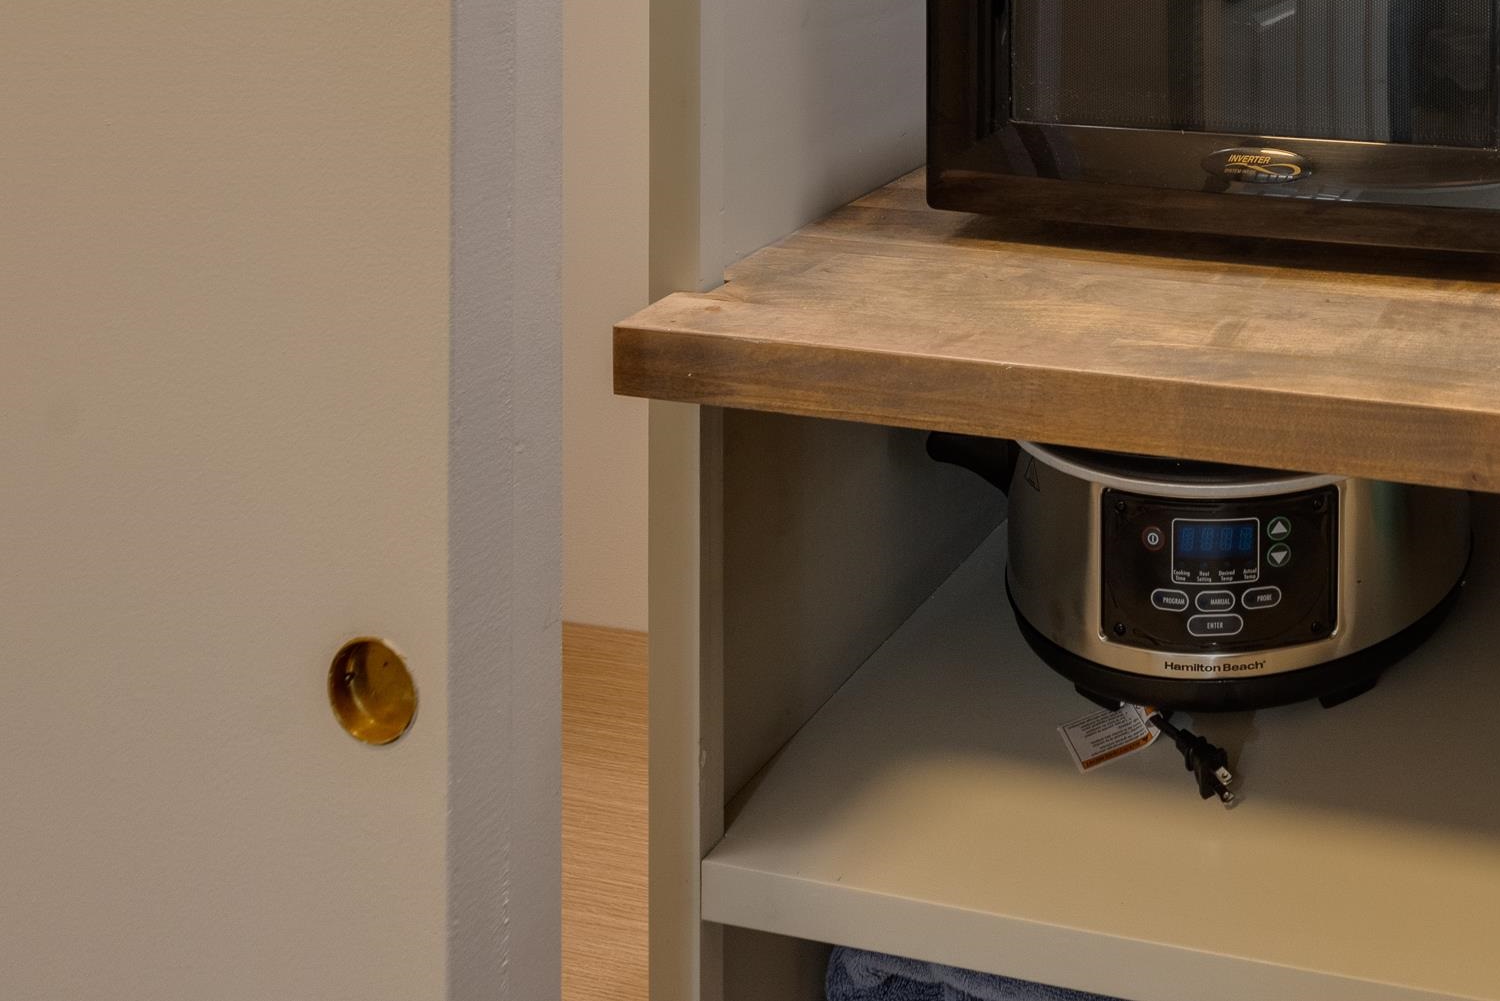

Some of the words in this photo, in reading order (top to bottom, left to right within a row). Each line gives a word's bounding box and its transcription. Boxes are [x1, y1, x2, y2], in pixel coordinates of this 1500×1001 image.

[1228, 154, 1271, 164] INVERTER
[1162, 596, 1185, 606] PROGRAM
[1210, 598, 1230, 606] MANUAL
[1206, 621, 1224, 630] ENTER
[1164, 661, 1221, 672] Hamilton
